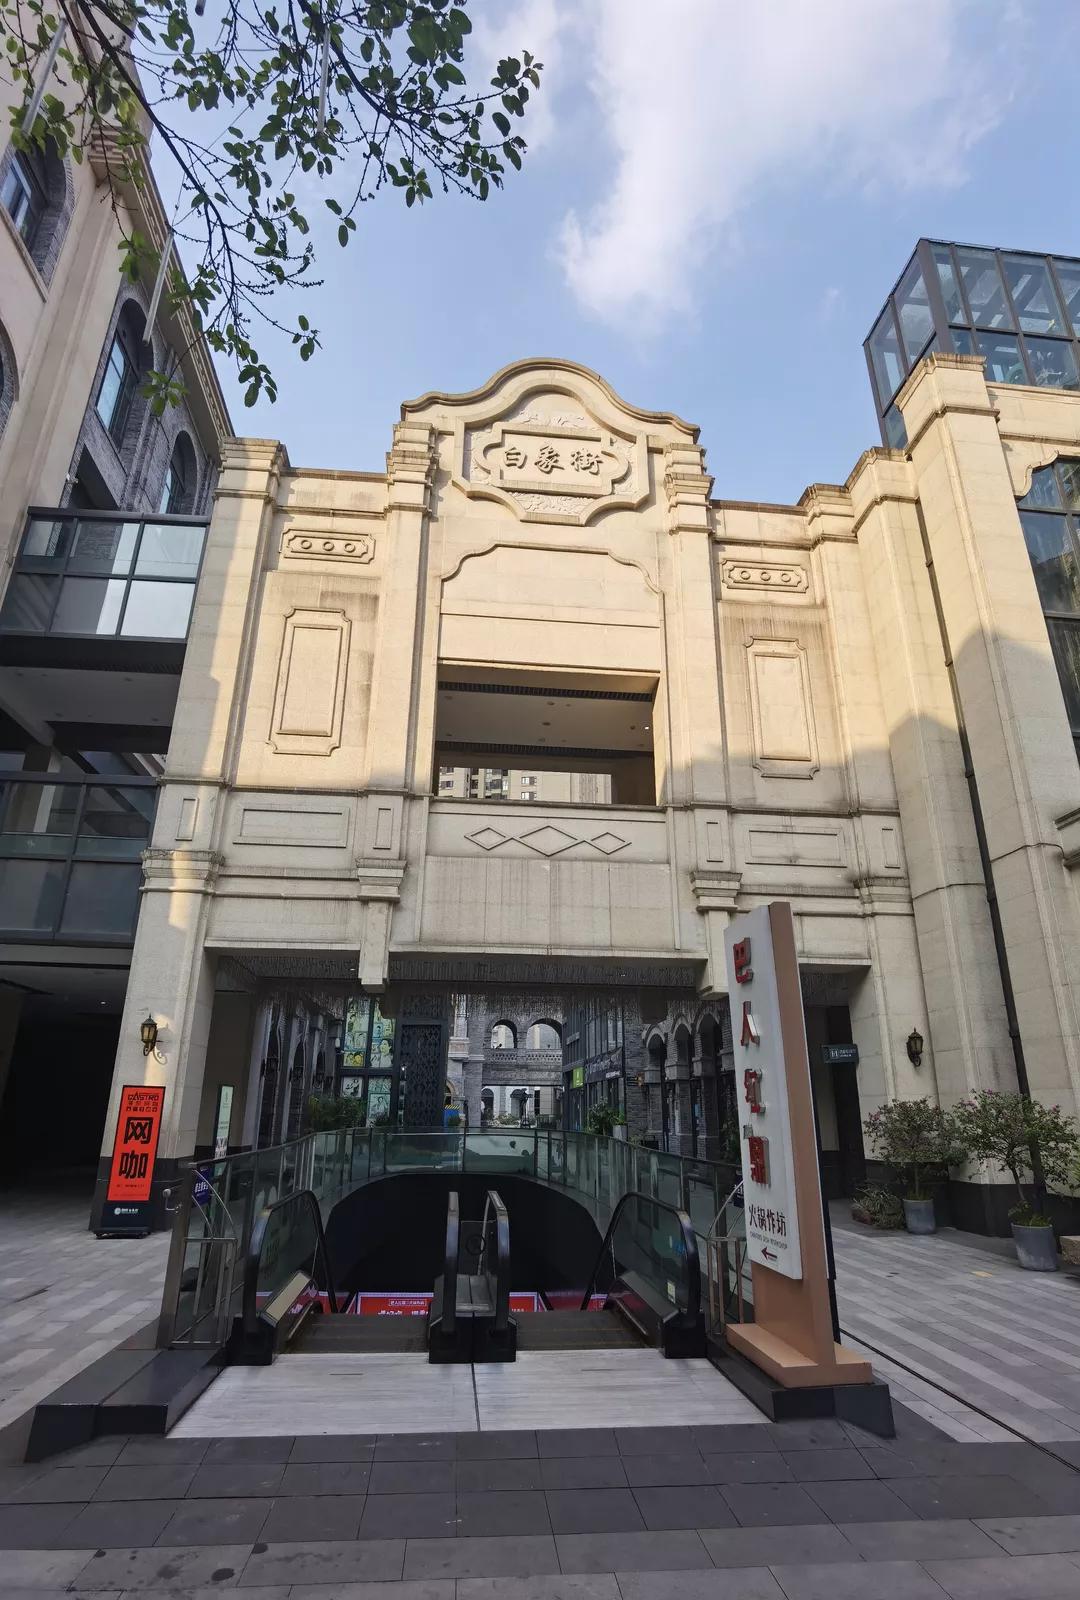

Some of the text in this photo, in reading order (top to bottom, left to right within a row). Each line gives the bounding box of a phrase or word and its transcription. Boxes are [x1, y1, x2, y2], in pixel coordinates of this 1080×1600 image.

[504, 442, 603, 475] 白象街
[119, 1116, 153, 1179] 网咖
[749, 1204, 787, 1237] 火锅作坊
